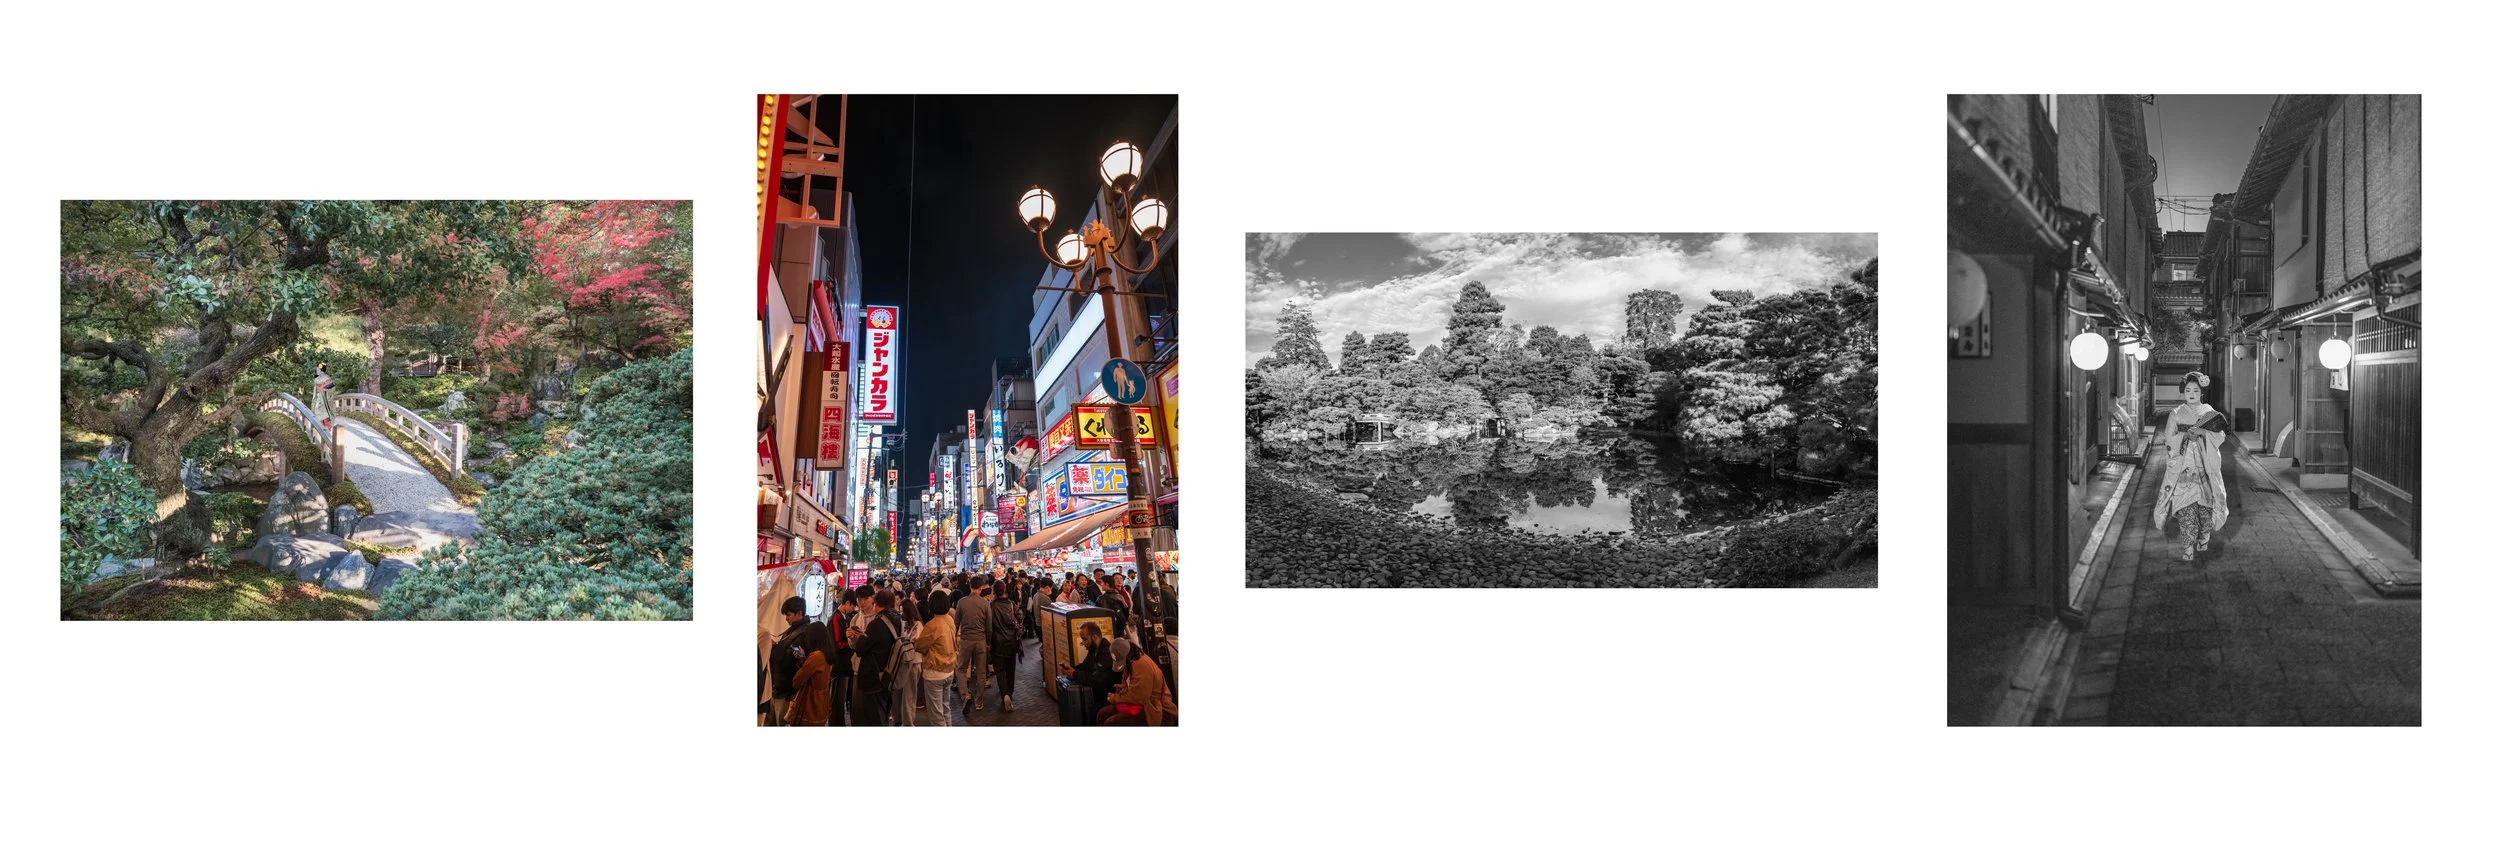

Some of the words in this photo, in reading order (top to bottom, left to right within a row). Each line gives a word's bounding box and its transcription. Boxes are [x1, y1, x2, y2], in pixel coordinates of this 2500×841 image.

[829, 371, 840, 399] 回転寿司
[870, 332, 889, 411] ジャンカラ
[1072, 465, 1090, 485] 薬
